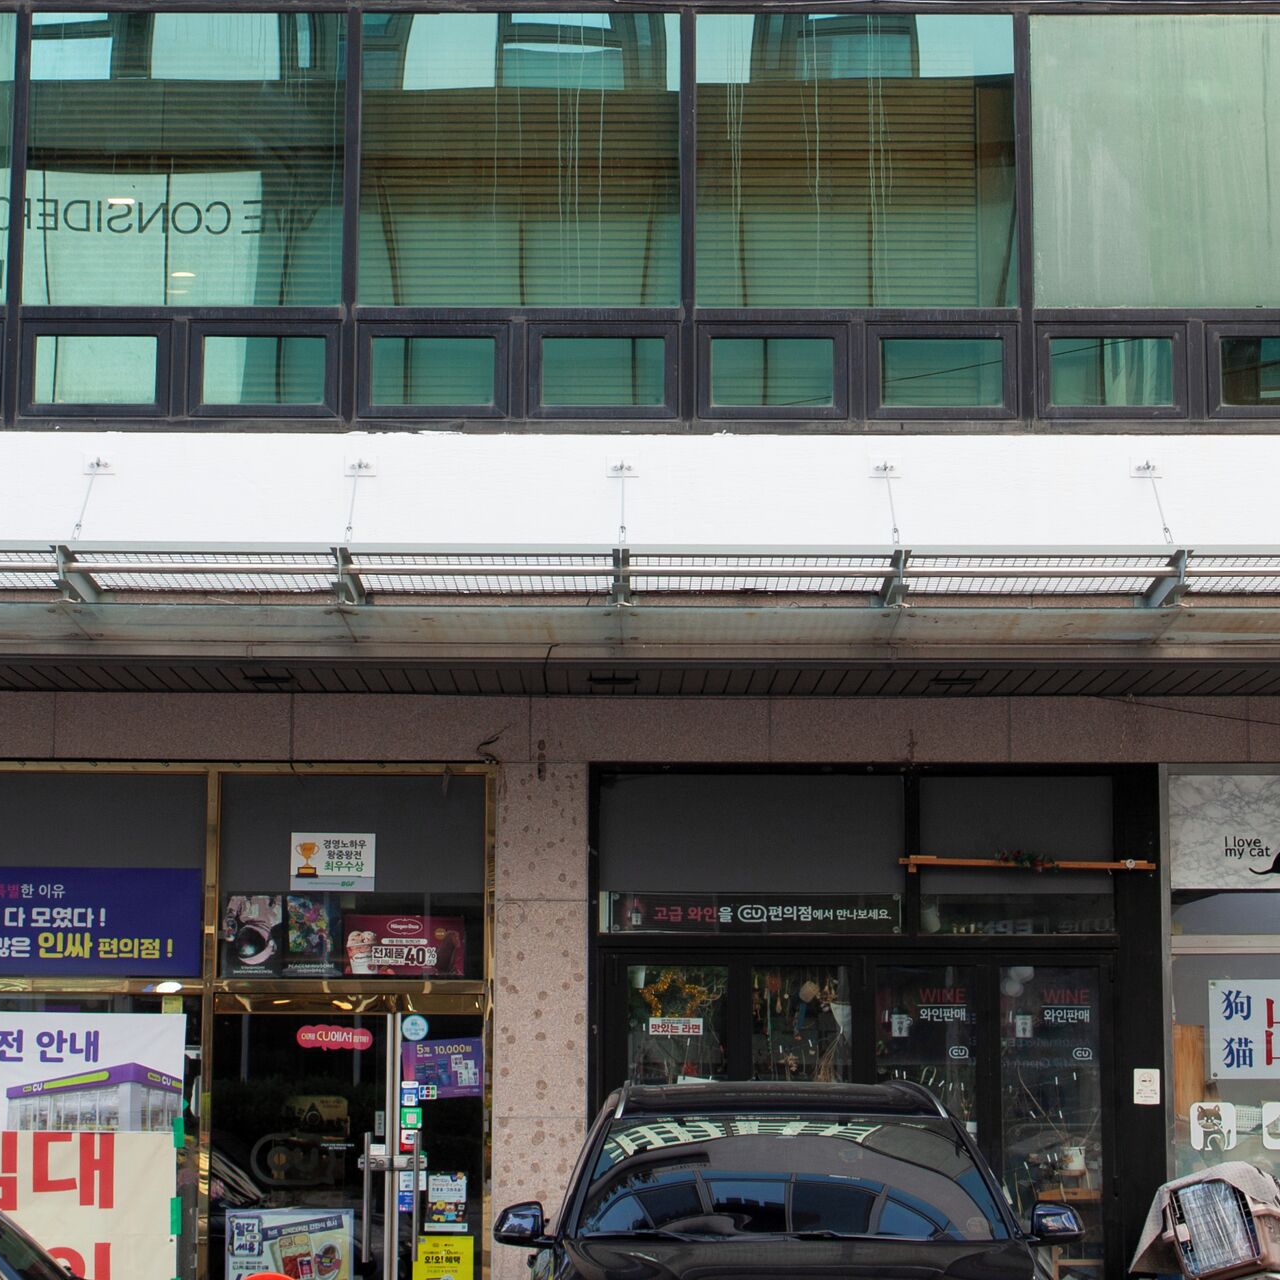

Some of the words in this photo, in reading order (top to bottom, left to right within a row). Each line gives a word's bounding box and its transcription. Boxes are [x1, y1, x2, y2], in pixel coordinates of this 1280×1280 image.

[322, 839, 367, 849] 경영노하우
[1234, 836, 1261, 847] love
[1225, 847, 1246, 859] my
[1249, 846, 1271, 857] cat
[324, 861, 364, 872] 최우수상
[38, 883, 66, 899] 이유
[4, 906, 26, 928] 다
[768, 906, 834, 922] 편의점에서
[836, 907, 892, 921] 만나보세요.
[37, 931, 93, 959] 인싸
[97, 938, 161, 959] 편의점
[920, 988, 967, 1004] WINE
[1041, 988, 1090, 1005] WINE
[1221, 990, 1252, 1021] 狗
[919, 1008, 967, 1022] 와인판매
[1043, 1009, 1090, 1023] 와인판매
[651, 1023, 679, 1034] 맛있는
[681, 1023, 701, 1034] 라면
[35, 1029, 101, 1063] 안내
[1223, 1037, 1254, 1068] 猫
[32, 1082, 43, 1092] CU
[161, 1076, 172, 1086] CU
